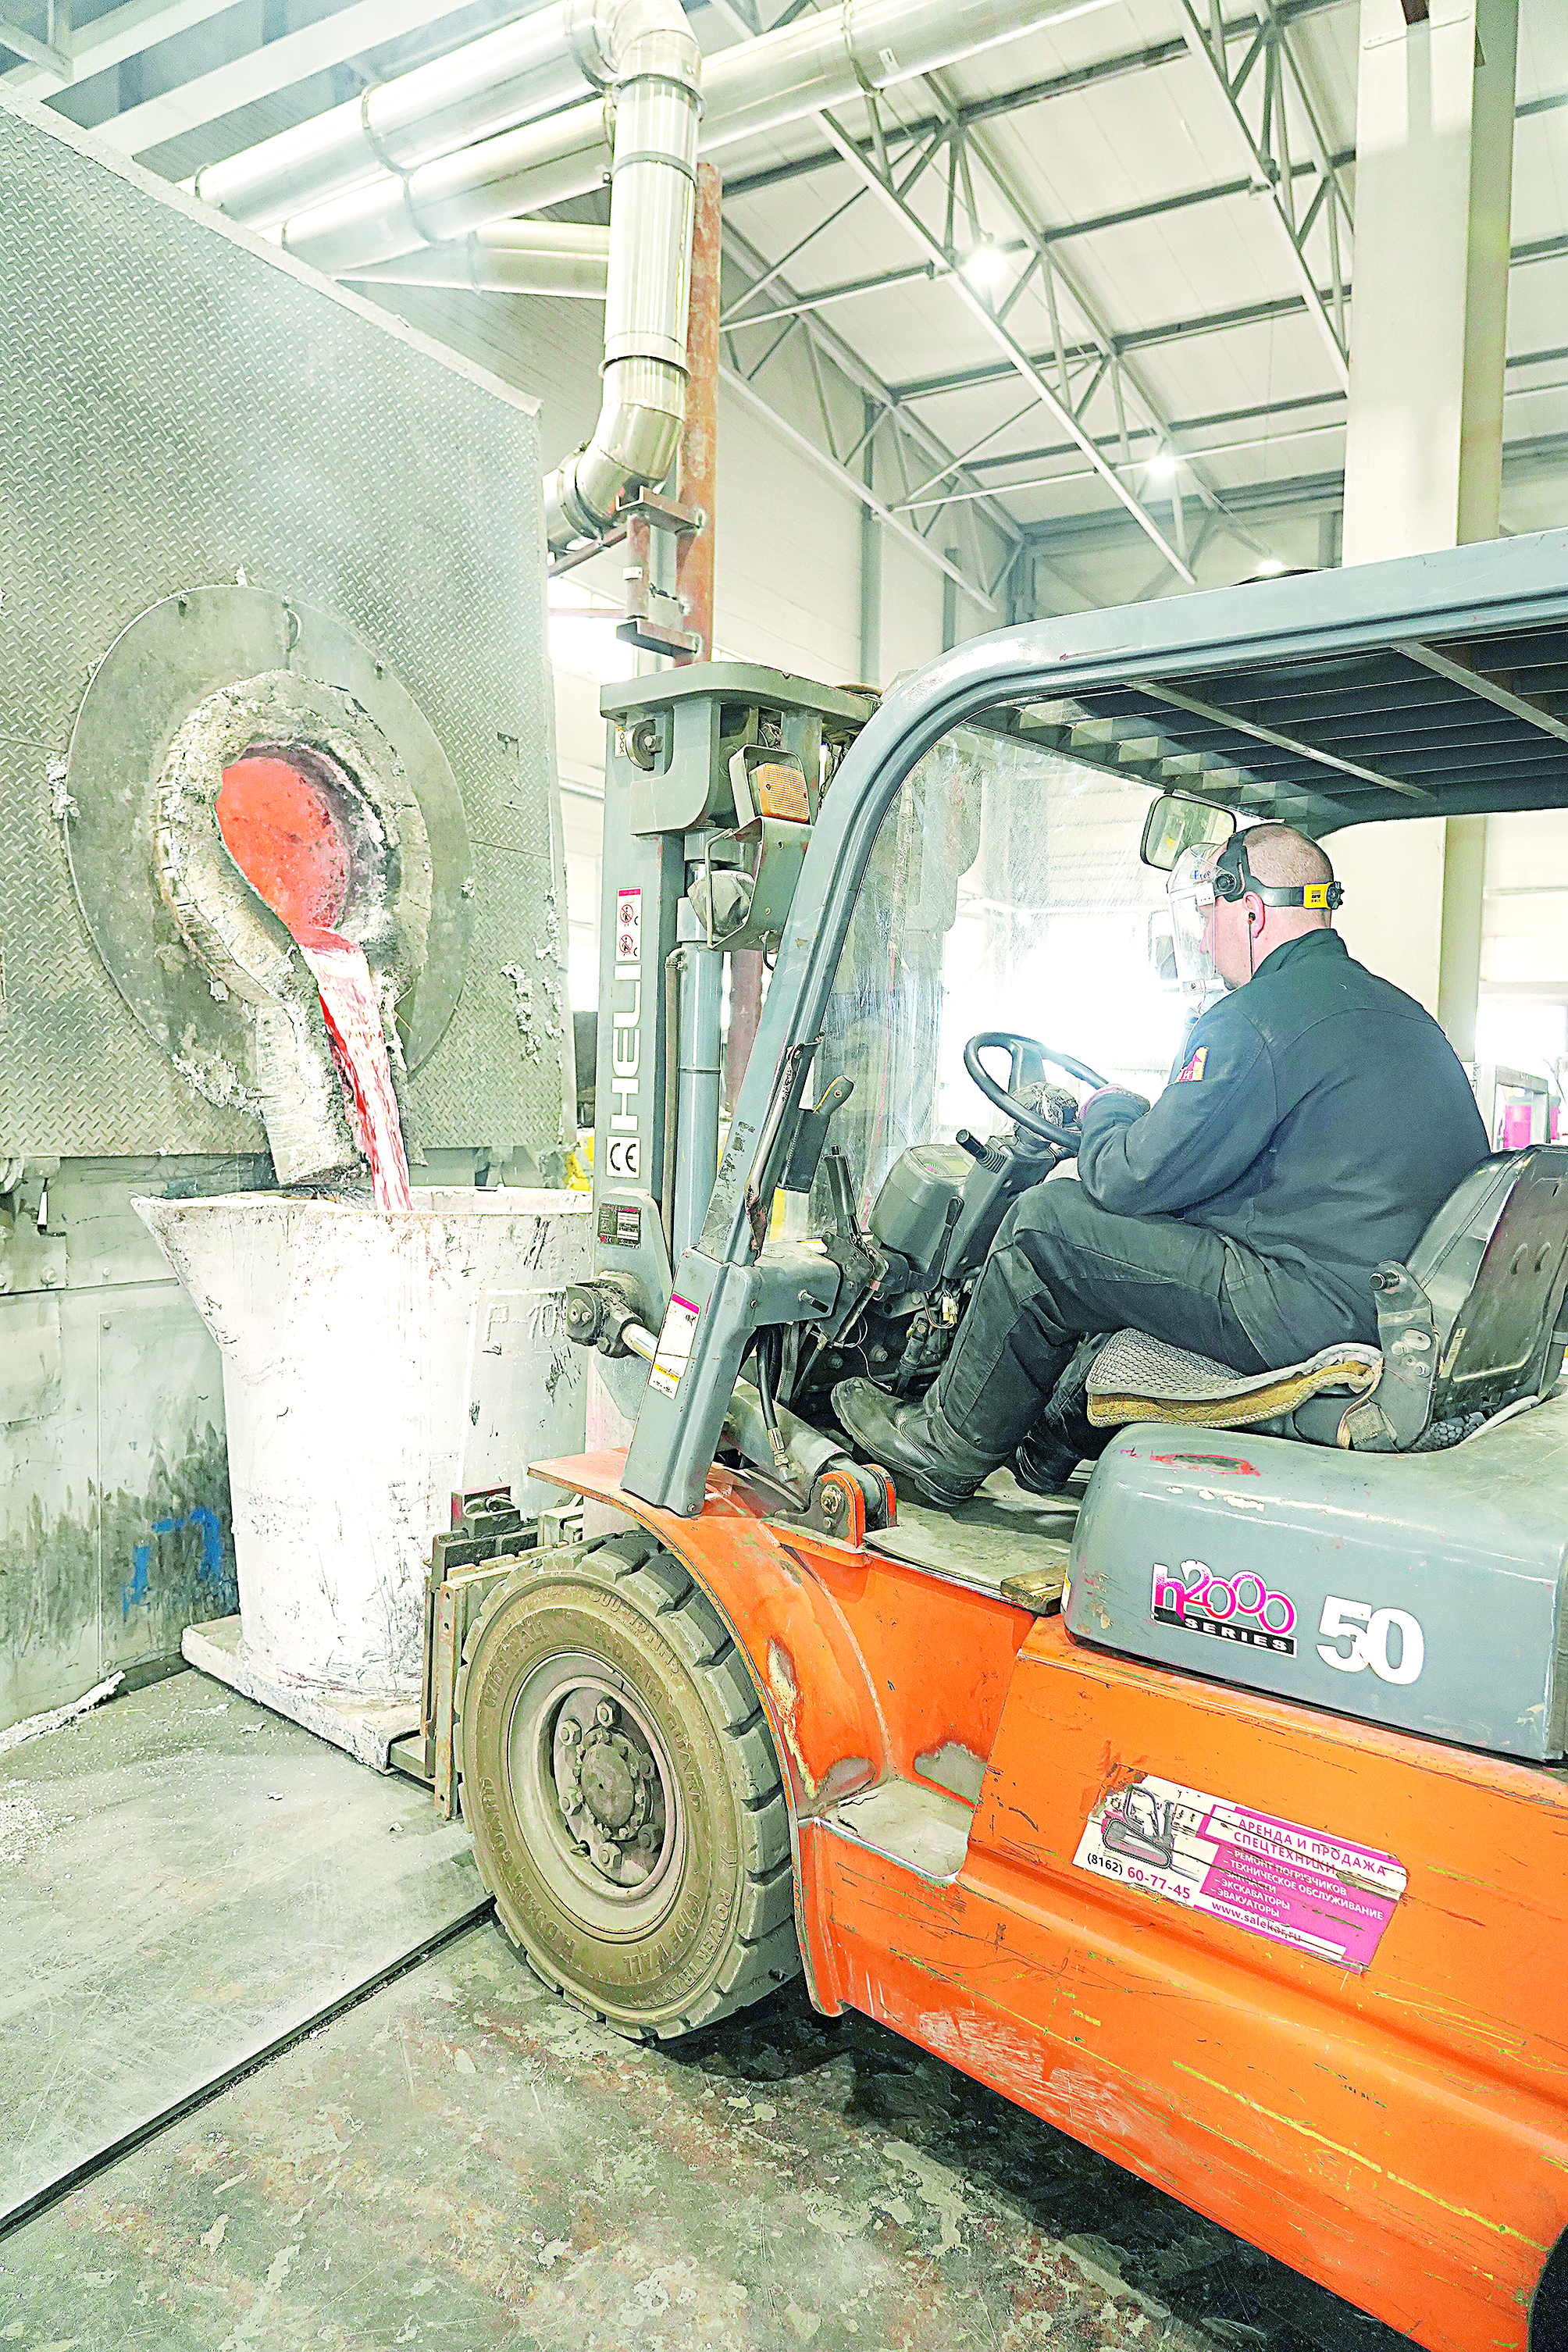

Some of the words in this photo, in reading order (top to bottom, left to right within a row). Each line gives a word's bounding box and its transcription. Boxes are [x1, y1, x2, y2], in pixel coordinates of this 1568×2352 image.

[610, 964, 641, 1131] HELI
[610, 1142, 636, 1172] CE
[1151, 1560, 1297, 1636] h2000
[1185, 1616, 1288, 1652] SERIES
[1316, 1595, 1424, 1685] 50
[1234, 1831, 1335, 1875] СПЕЦТЕХНИКИ
[1238, 1819, 1292, 1845] АРЕНДА
[1297, 1837, 1306, 1850] И
[1312, 1843, 1386, 1876] ПРОДАЖА
[1087, 1853, 1123, 1875] (8162)
[1128, 1866, 1190, 1899] 60-77-45
[1221, 1878, 1291, 1911] ЭКСКАВАТОРЫ
[1230, 1858, 1297, 1890] ТЕХНИЧЕСКОЕ
[1298, 1880, 1384, 1921] ОБСЛУЖИВАНИЕ
[1234, 1849, 1274, 1869] РЕМОНТ
[1276, 1864, 1348, 1896] ПОГРУЗЧИКОВ
[695, 1887, 732, 1965] POWER
[1217, 1887, 1280, 1918] ЭВАКУАТОРЫ
